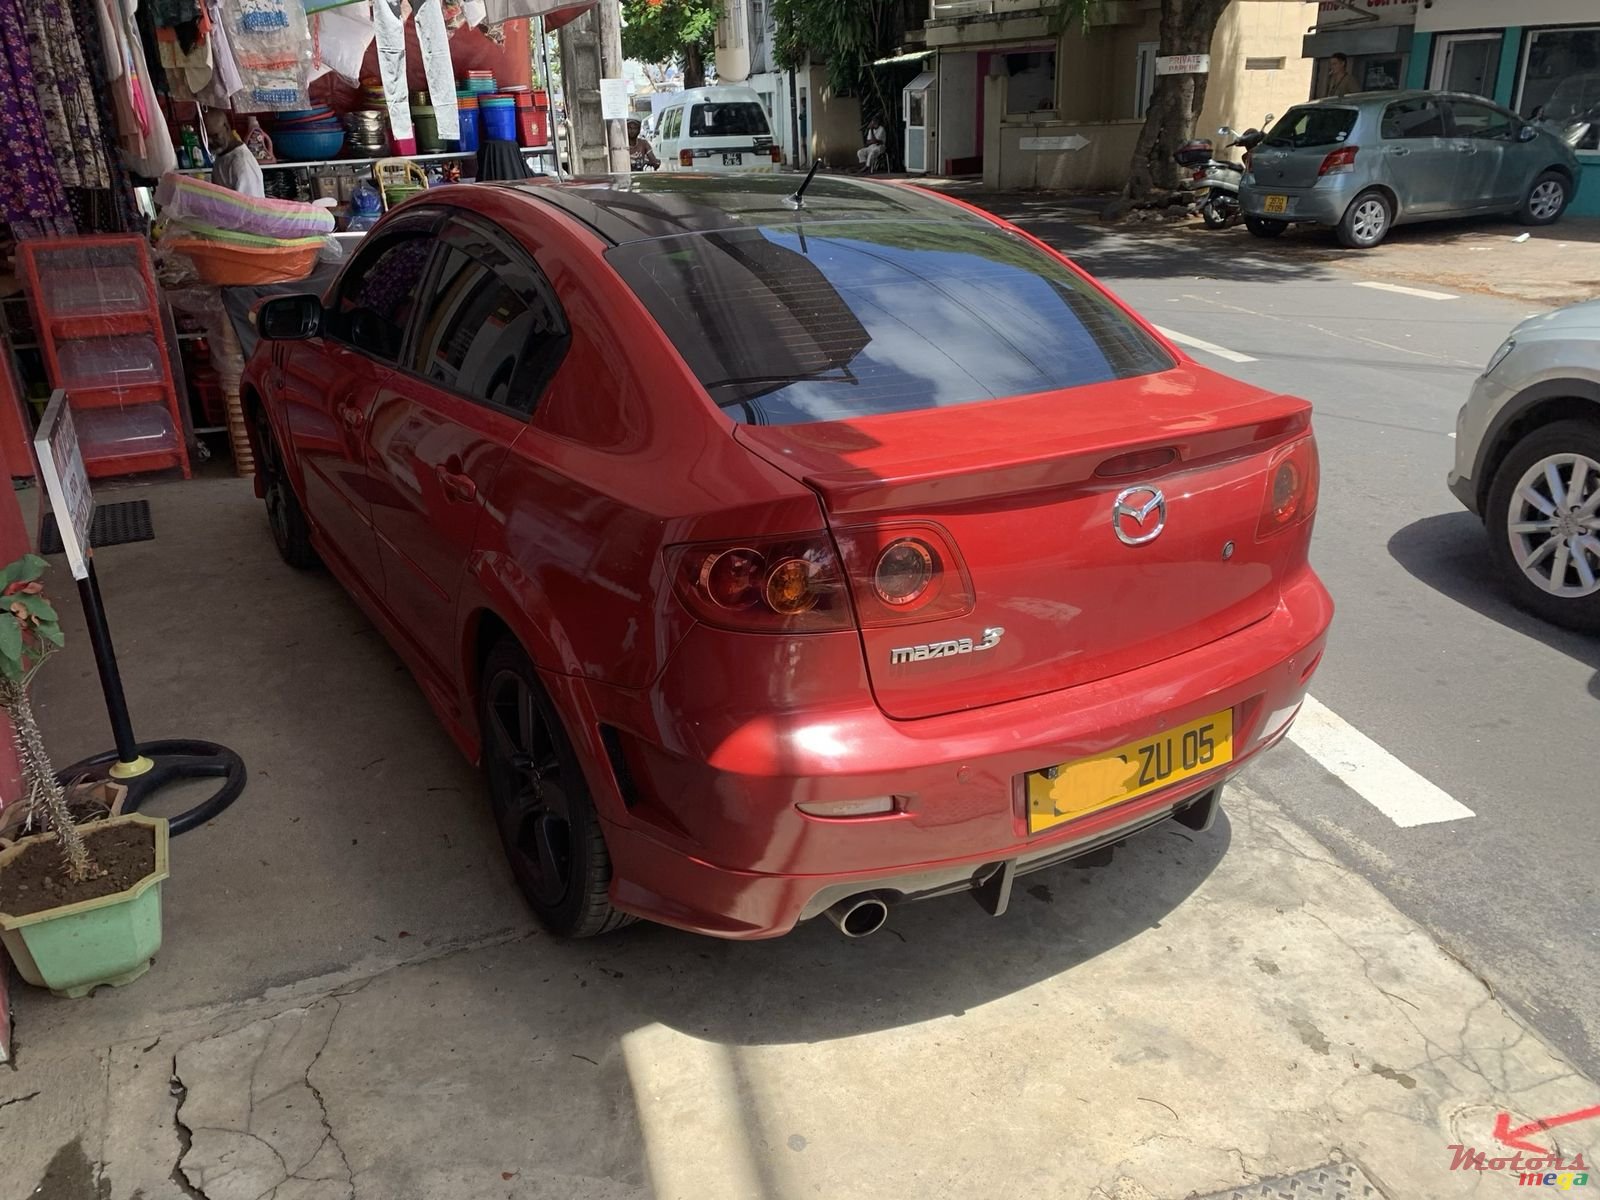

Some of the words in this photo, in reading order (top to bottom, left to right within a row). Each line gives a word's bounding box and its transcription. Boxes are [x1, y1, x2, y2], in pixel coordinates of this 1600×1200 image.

[1168, 55, 1201, 64] PRIVATE
[1138, 738, 1172, 787] ZU
[1182, 724, 1214, 771] 05
